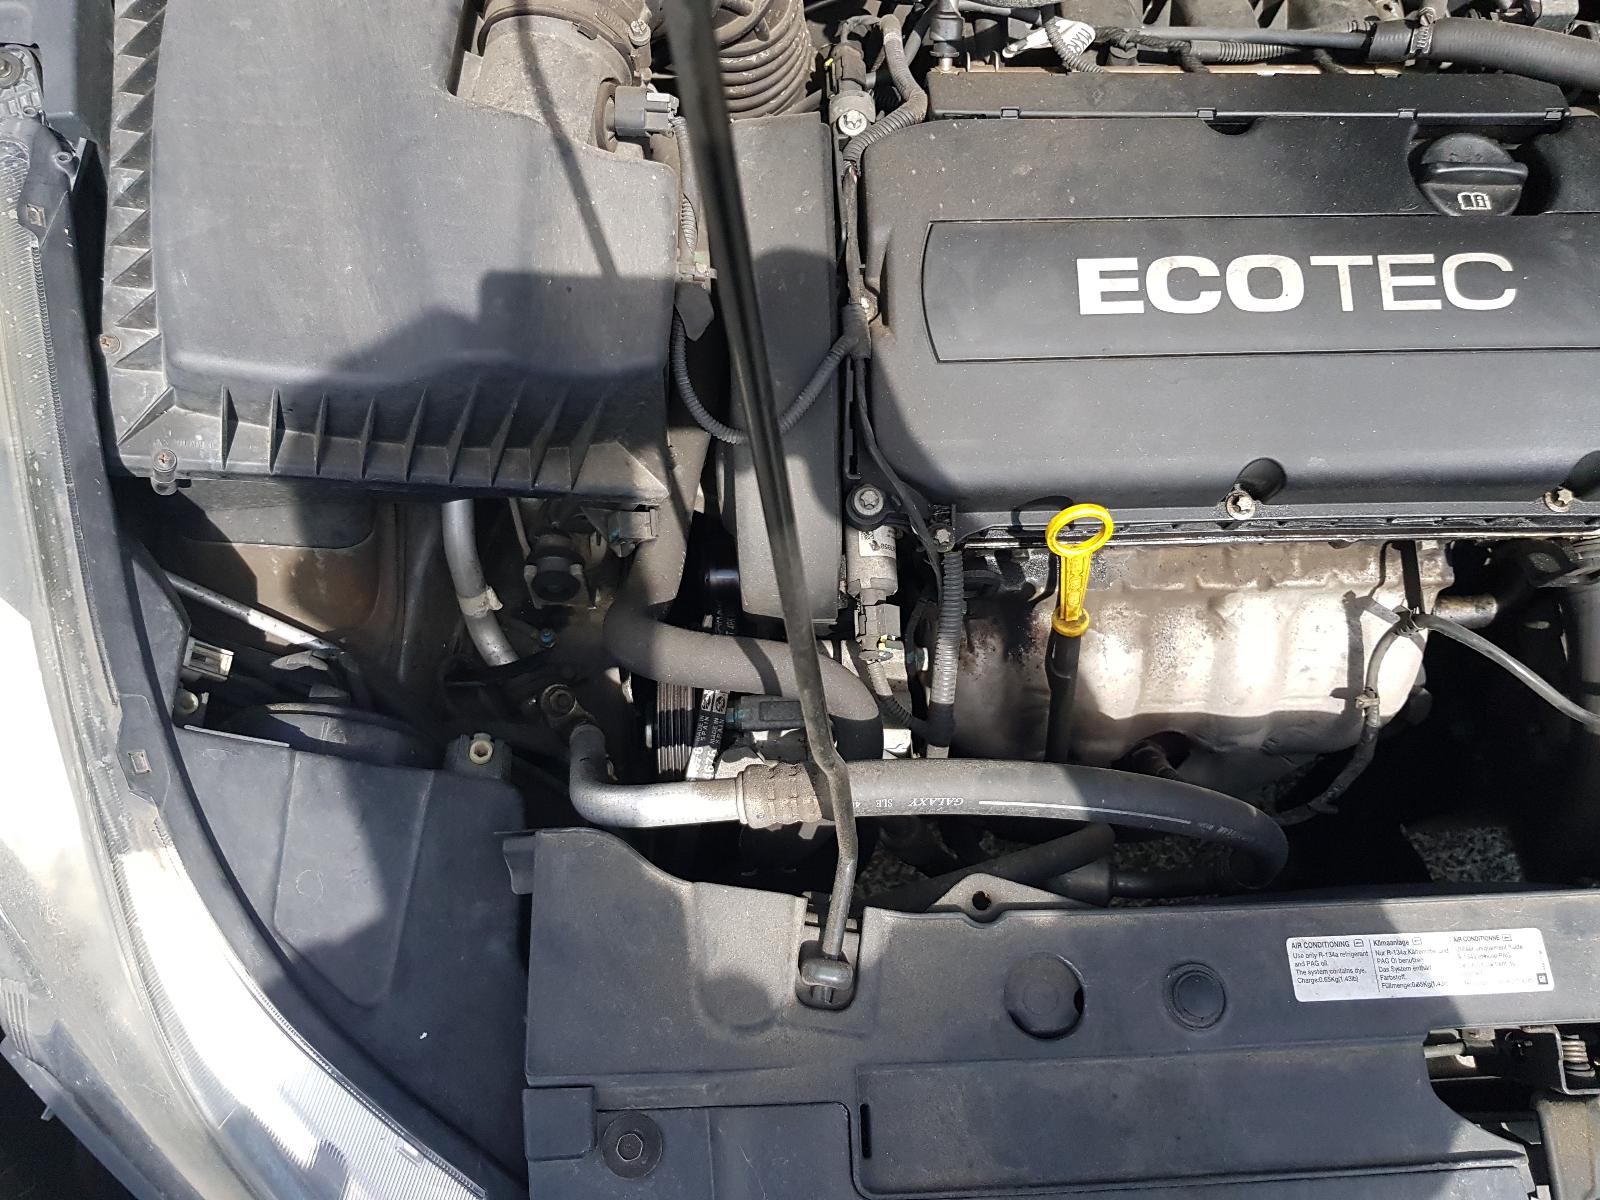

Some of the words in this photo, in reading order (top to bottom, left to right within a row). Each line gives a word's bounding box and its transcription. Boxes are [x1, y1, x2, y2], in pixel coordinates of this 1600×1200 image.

[1077, 253, 1517, 315] ECOTEC
[696, 722, 704, 742] MADE
[700, 715, 710, 741] SPAIN
[875, 798, 893, 808] SLE
[908, 797, 964, 807] GALAXY
[1303, 940, 1350, 949] CONDITIONING
[1340, 950, 1369, 958] refrigerant
[1307, 968, 1328, 976] system
[1390, 965, 1411, 973] System
